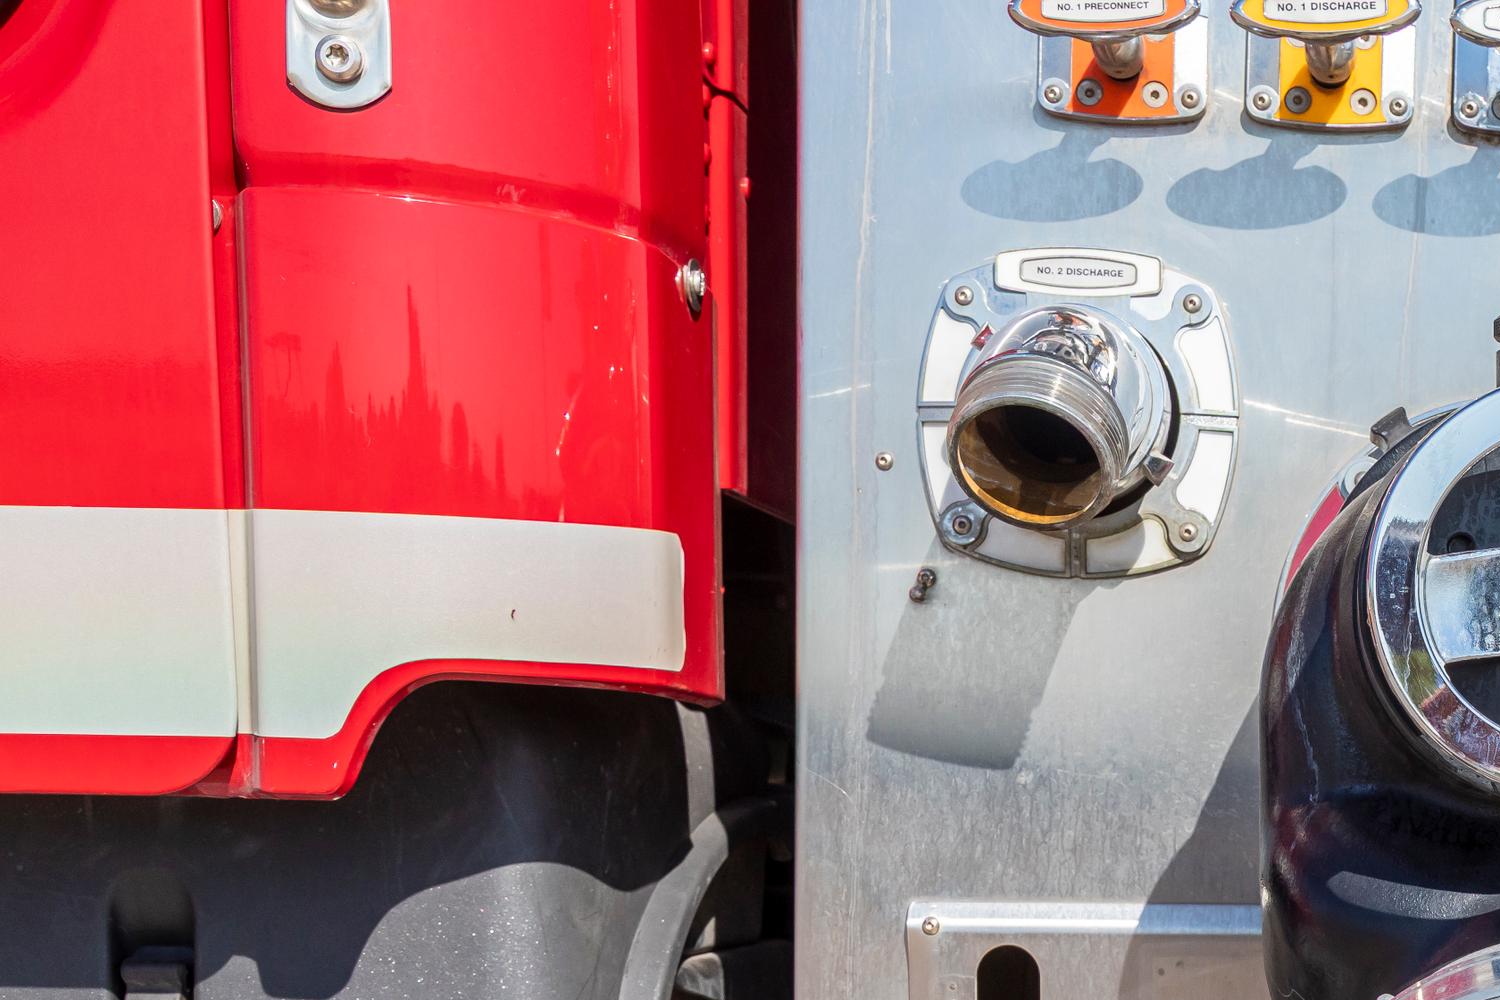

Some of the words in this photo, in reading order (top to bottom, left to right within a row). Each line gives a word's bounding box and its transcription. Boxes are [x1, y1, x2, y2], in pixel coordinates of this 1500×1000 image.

[1057, 3, 1073, 11] NO.
[1084, 1, 1149, 10] PRECONNECT
[1277, 3, 1297, 12] NO.
[1310, 1, 1377, 11] DISCHARGE
[1037, 266, 1054, 275] NO.
[1058, 267, 1063, 275] 2
[1066, 267, 1124, 278] DISCHARGE
